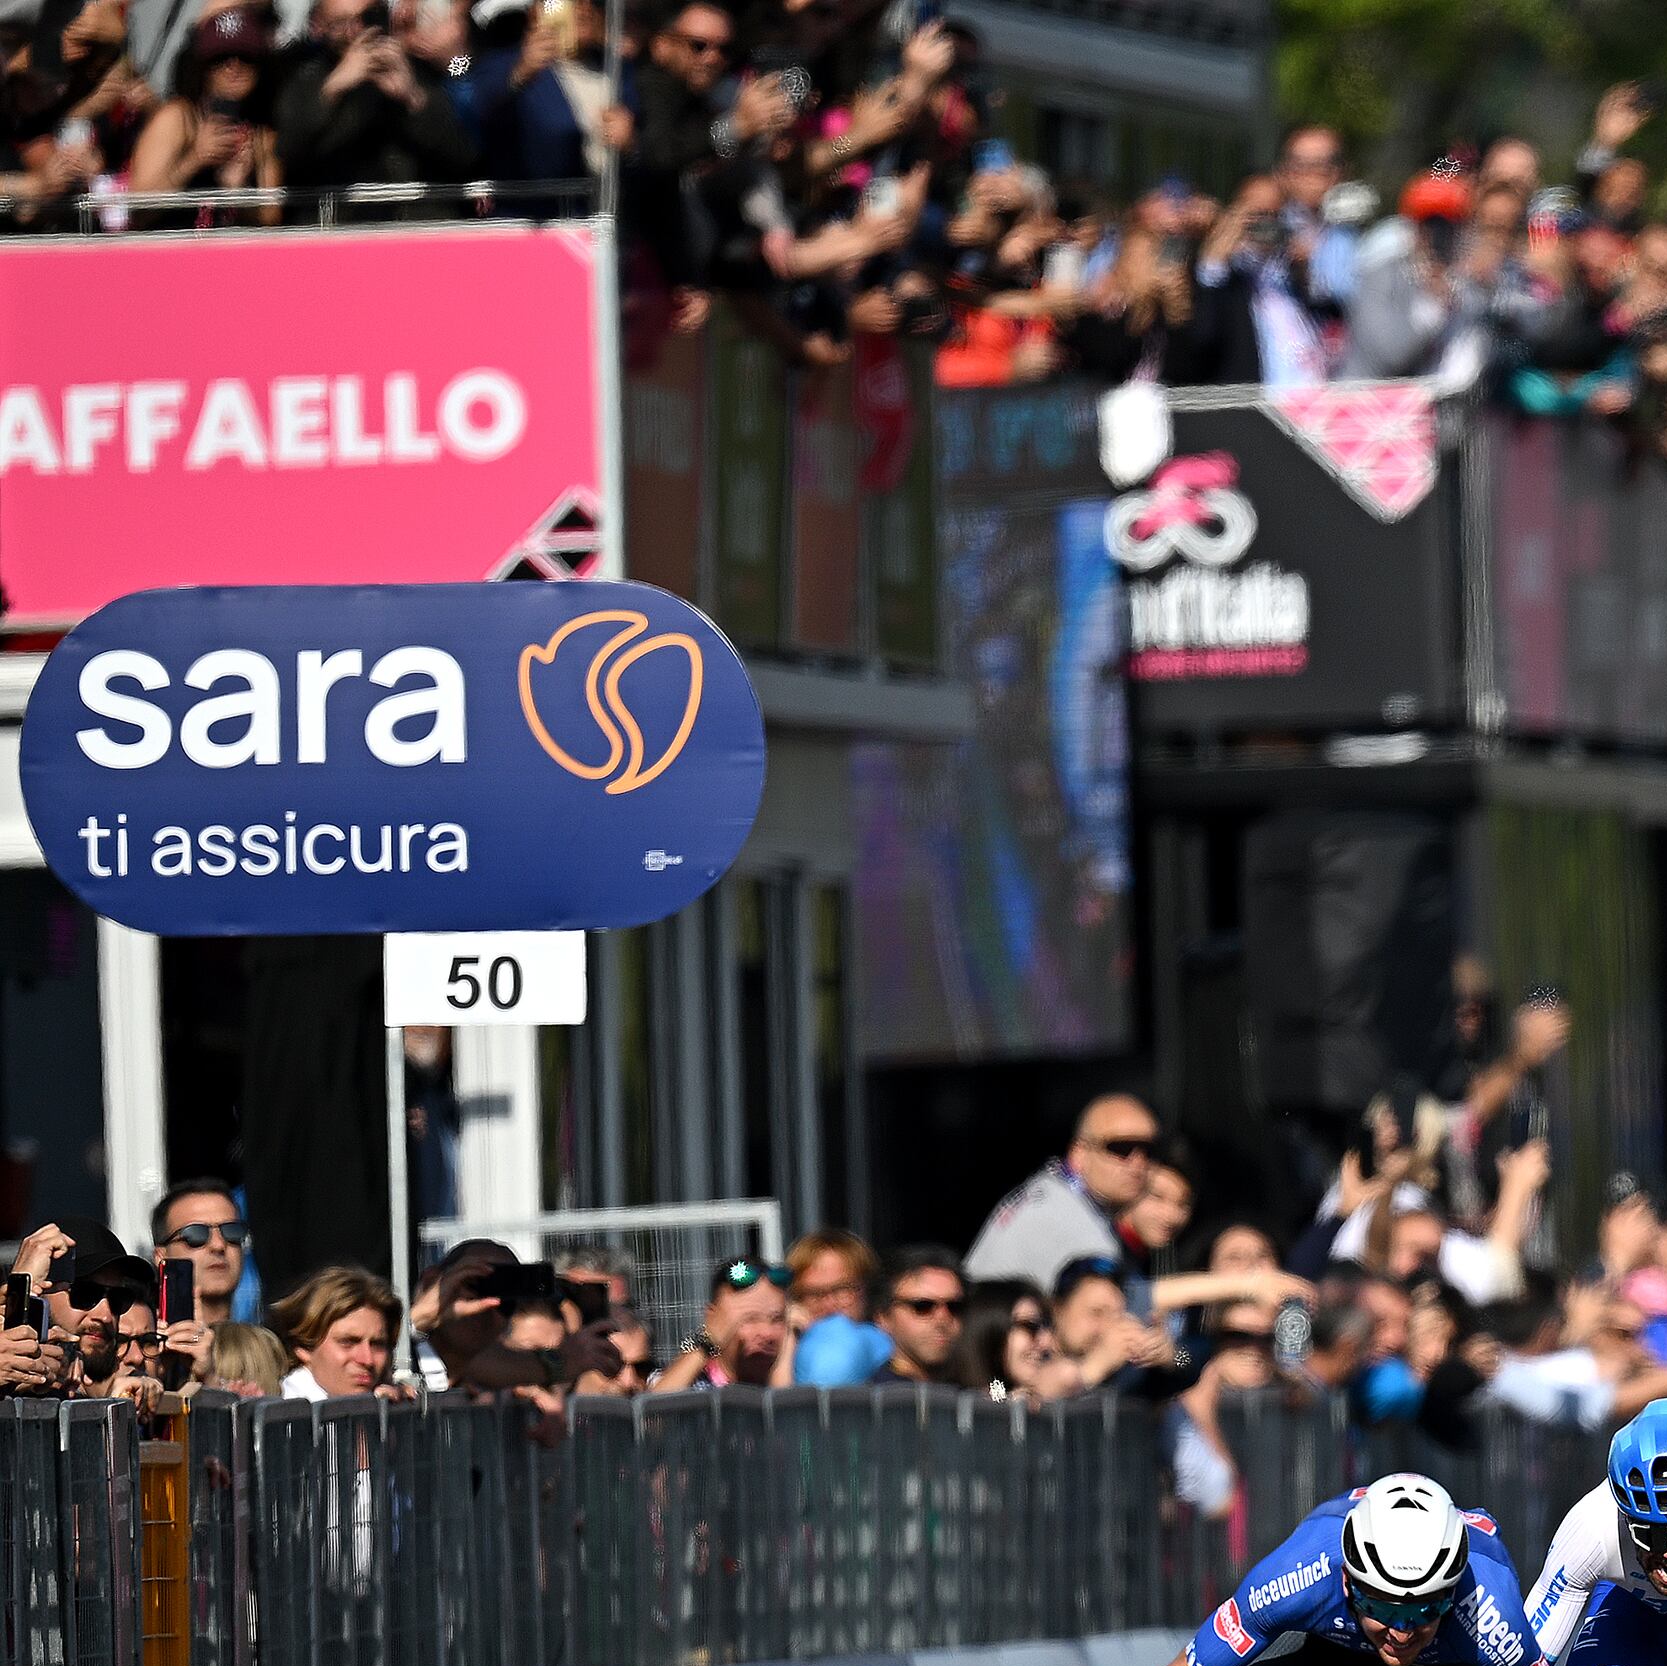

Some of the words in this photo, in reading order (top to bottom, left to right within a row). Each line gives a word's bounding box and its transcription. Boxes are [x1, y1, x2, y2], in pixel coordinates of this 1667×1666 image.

[77, 645, 468, 769] sara
[78, 813, 129, 878] ti
[150, 810, 470, 878] assicura
[446, 956, 524, 1012] 50
[1249, 1552, 1331, 1613] deceuninck
[1530, 1564, 1569, 1634] GIANT
